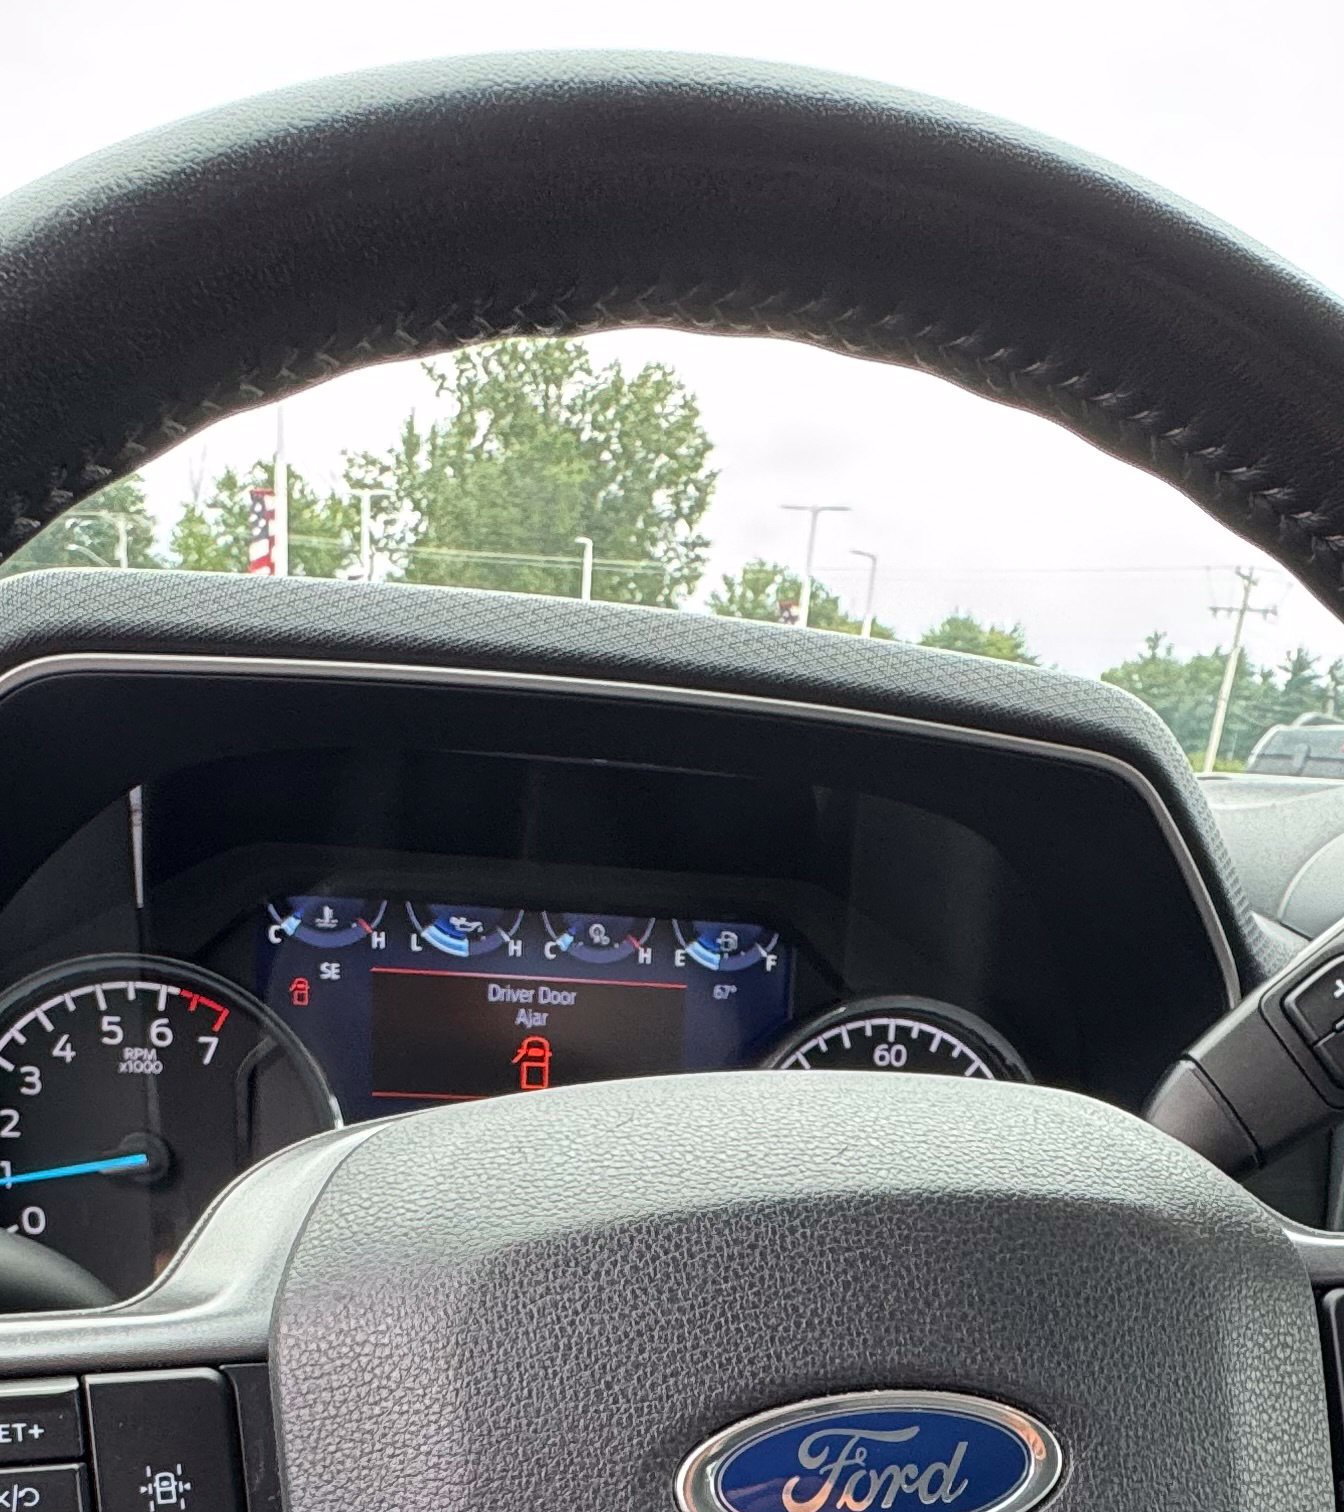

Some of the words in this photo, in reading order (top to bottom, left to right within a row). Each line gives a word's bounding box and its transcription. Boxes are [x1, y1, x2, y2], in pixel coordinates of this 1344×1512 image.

[268, 924, 283, 944] C
[371, 931, 386, 950] H
[410, 933, 423, 951] L
[508, 939, 522, 957] H
[544, 941, 557, 960] C
[638, 948, 652, 964] H
[674, 950, 687, 968] E
[766, 954, 778, 971] F
[319, 961, 341, 980] SE
[487, 983, 535, 1003] Driver
[538, 985, 577, 1006] Door
[515, 1008, 549, 1028] Ajar
[101, 1016, 124, 1045] 5
[149, 1018, 174, 1048] 6
[52, 1034, 76, 1063] 4
[123, 1047, 158, 1061] RPM
[197, 1036, 219, 1066] 7
[873, 1043, 908, 1068] 60
[119, 1061, 164, 1075] x1000
[19, 1065, 43, 1096] 3
[0, 1108, 21, 1139] 2
[0, 1160, 13, 1190] 1
[21, 1206, 47, 1235] 0
